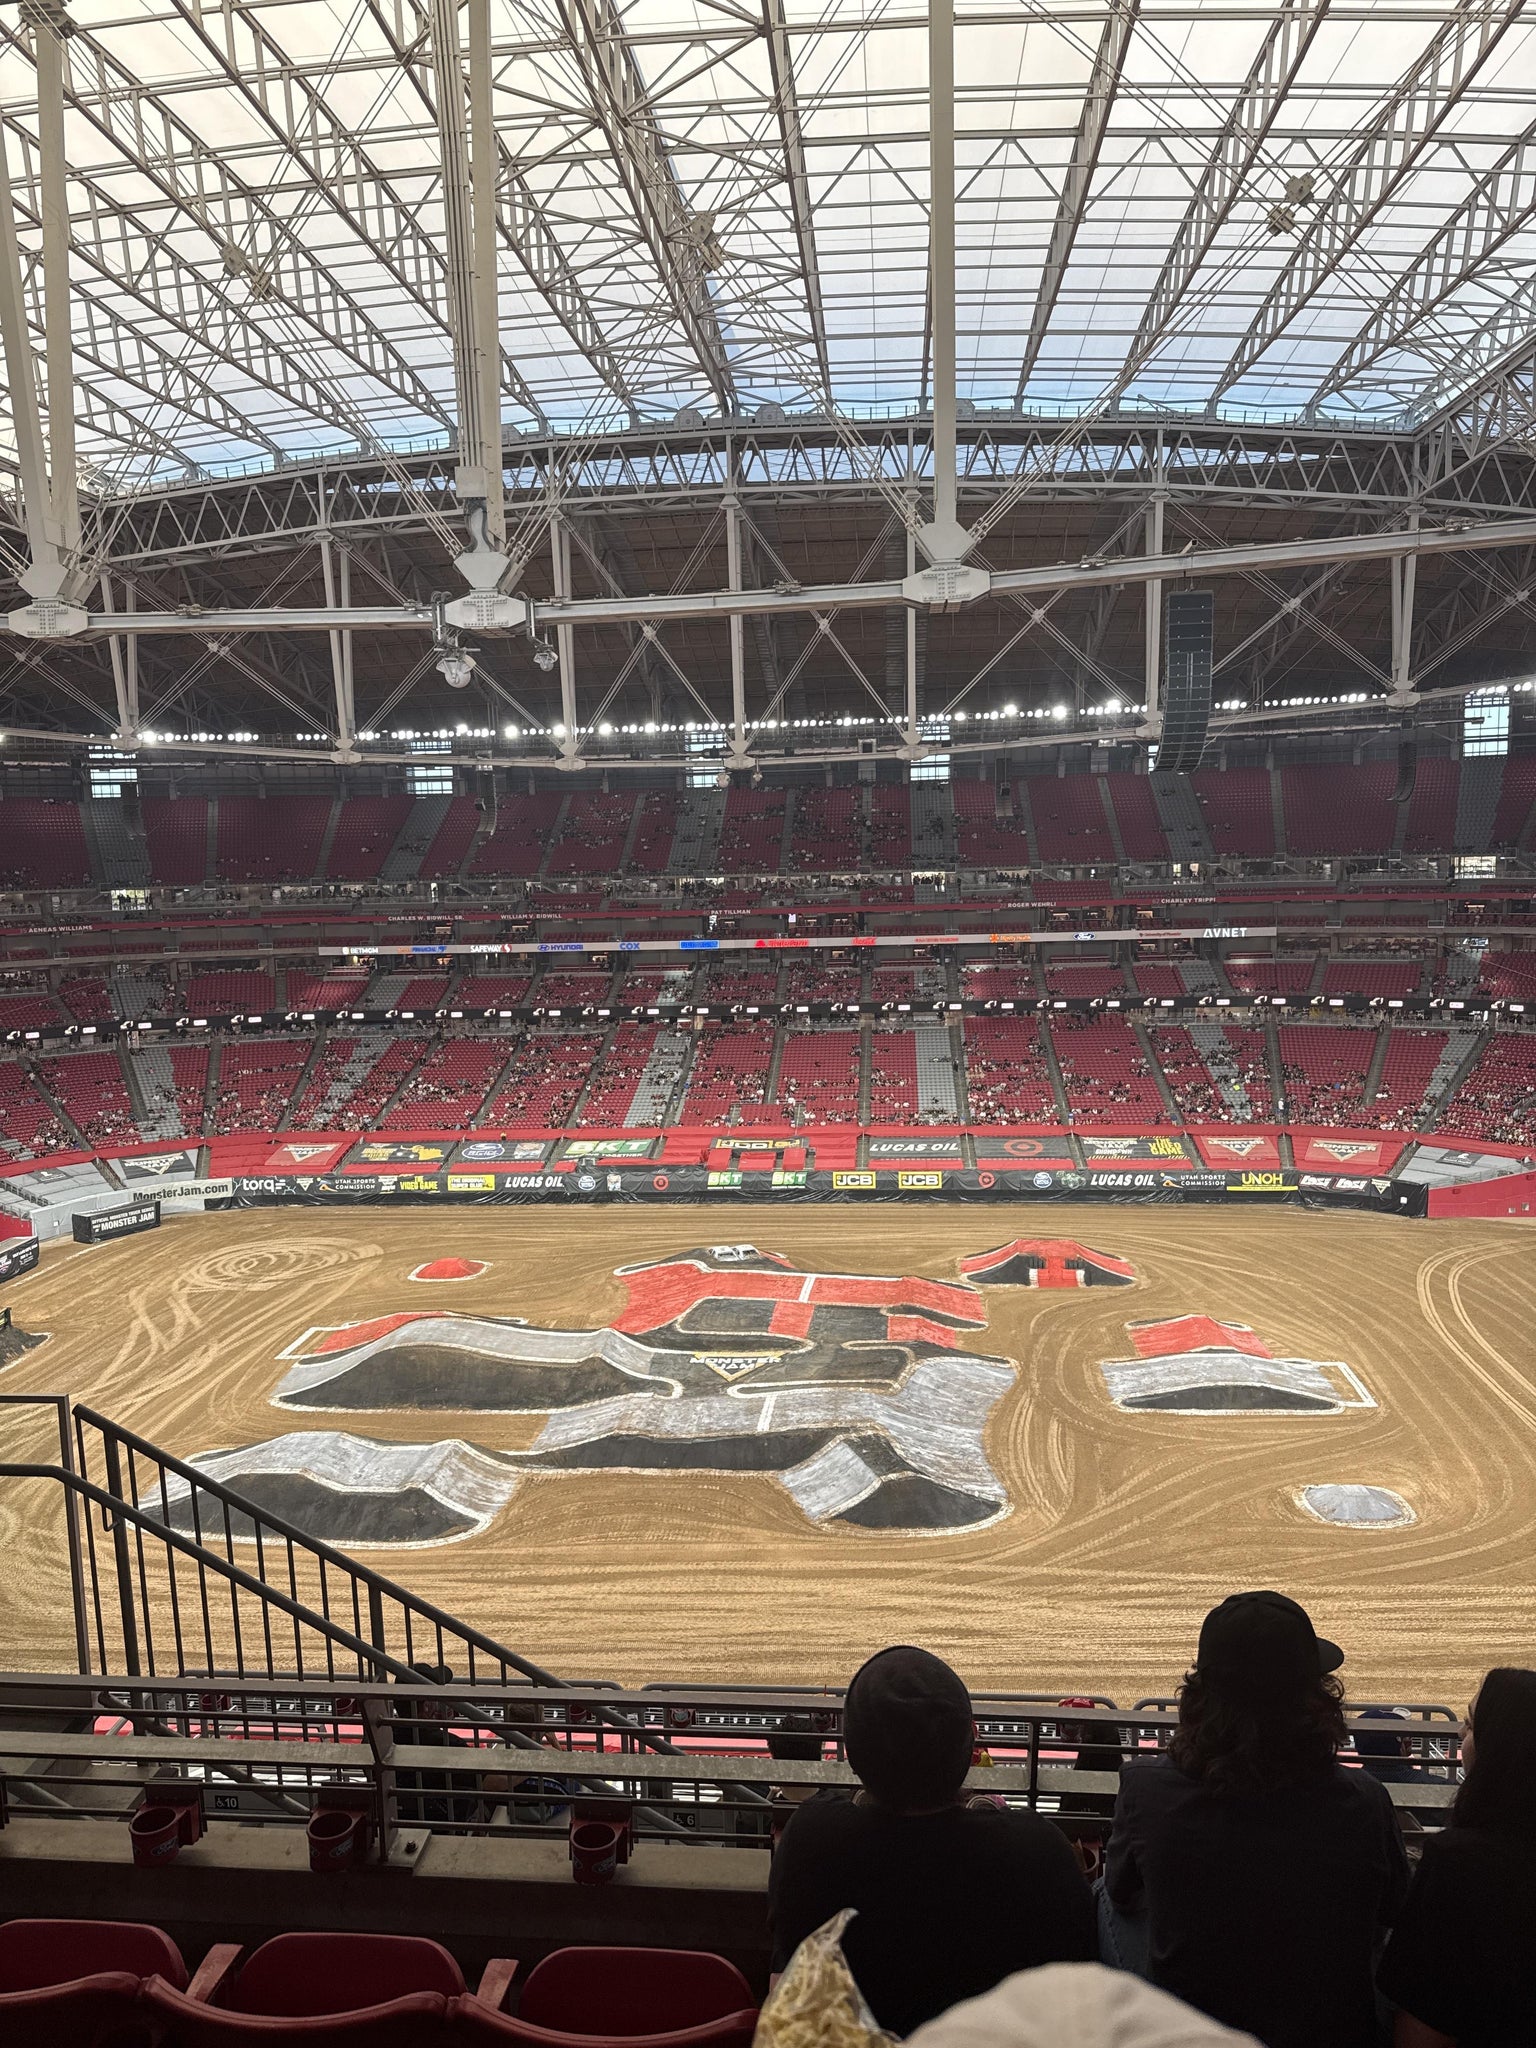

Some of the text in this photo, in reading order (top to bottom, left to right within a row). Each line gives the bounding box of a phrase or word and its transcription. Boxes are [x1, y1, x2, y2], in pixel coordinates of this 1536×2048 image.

[1203, 927, 1248, 938] AVNET
[470, 945, 502, 953] SAFEWAY
[619, 942, 640, 950] COX
[570, 1141, 649, 1153] BKT
[869, 1143, 928, 1152] LUCAS
[1151, 1147, 1185, 1155] GAME
[1312, 1143, 1377, 1152] MONSTER
[505, 1176, 543, 1188] LUCAS
[708, 1173, 742, 1185] BKT
[772, 1172, 806, 1185] BKT
[836, 1174, 873, 1185] JCB
[902, 1174, 939, 1185] JCB
[1090, 1174, 1133, 1186] LUCAS
[1241, 1171, 1283, 1185] UNOH
[400, 1181, 420, 1190] VIDEO
[420, 1181, 438, 1190] GAME
[133, 1183, 229, 1201] MonsterJam.com
[101, 1216, 137, 1231] MONSTER
[138, 1211, 155, 1222] JAM
[224, 1797, 238, 1808] 10
[686, 1814, 695, 1826] 6
